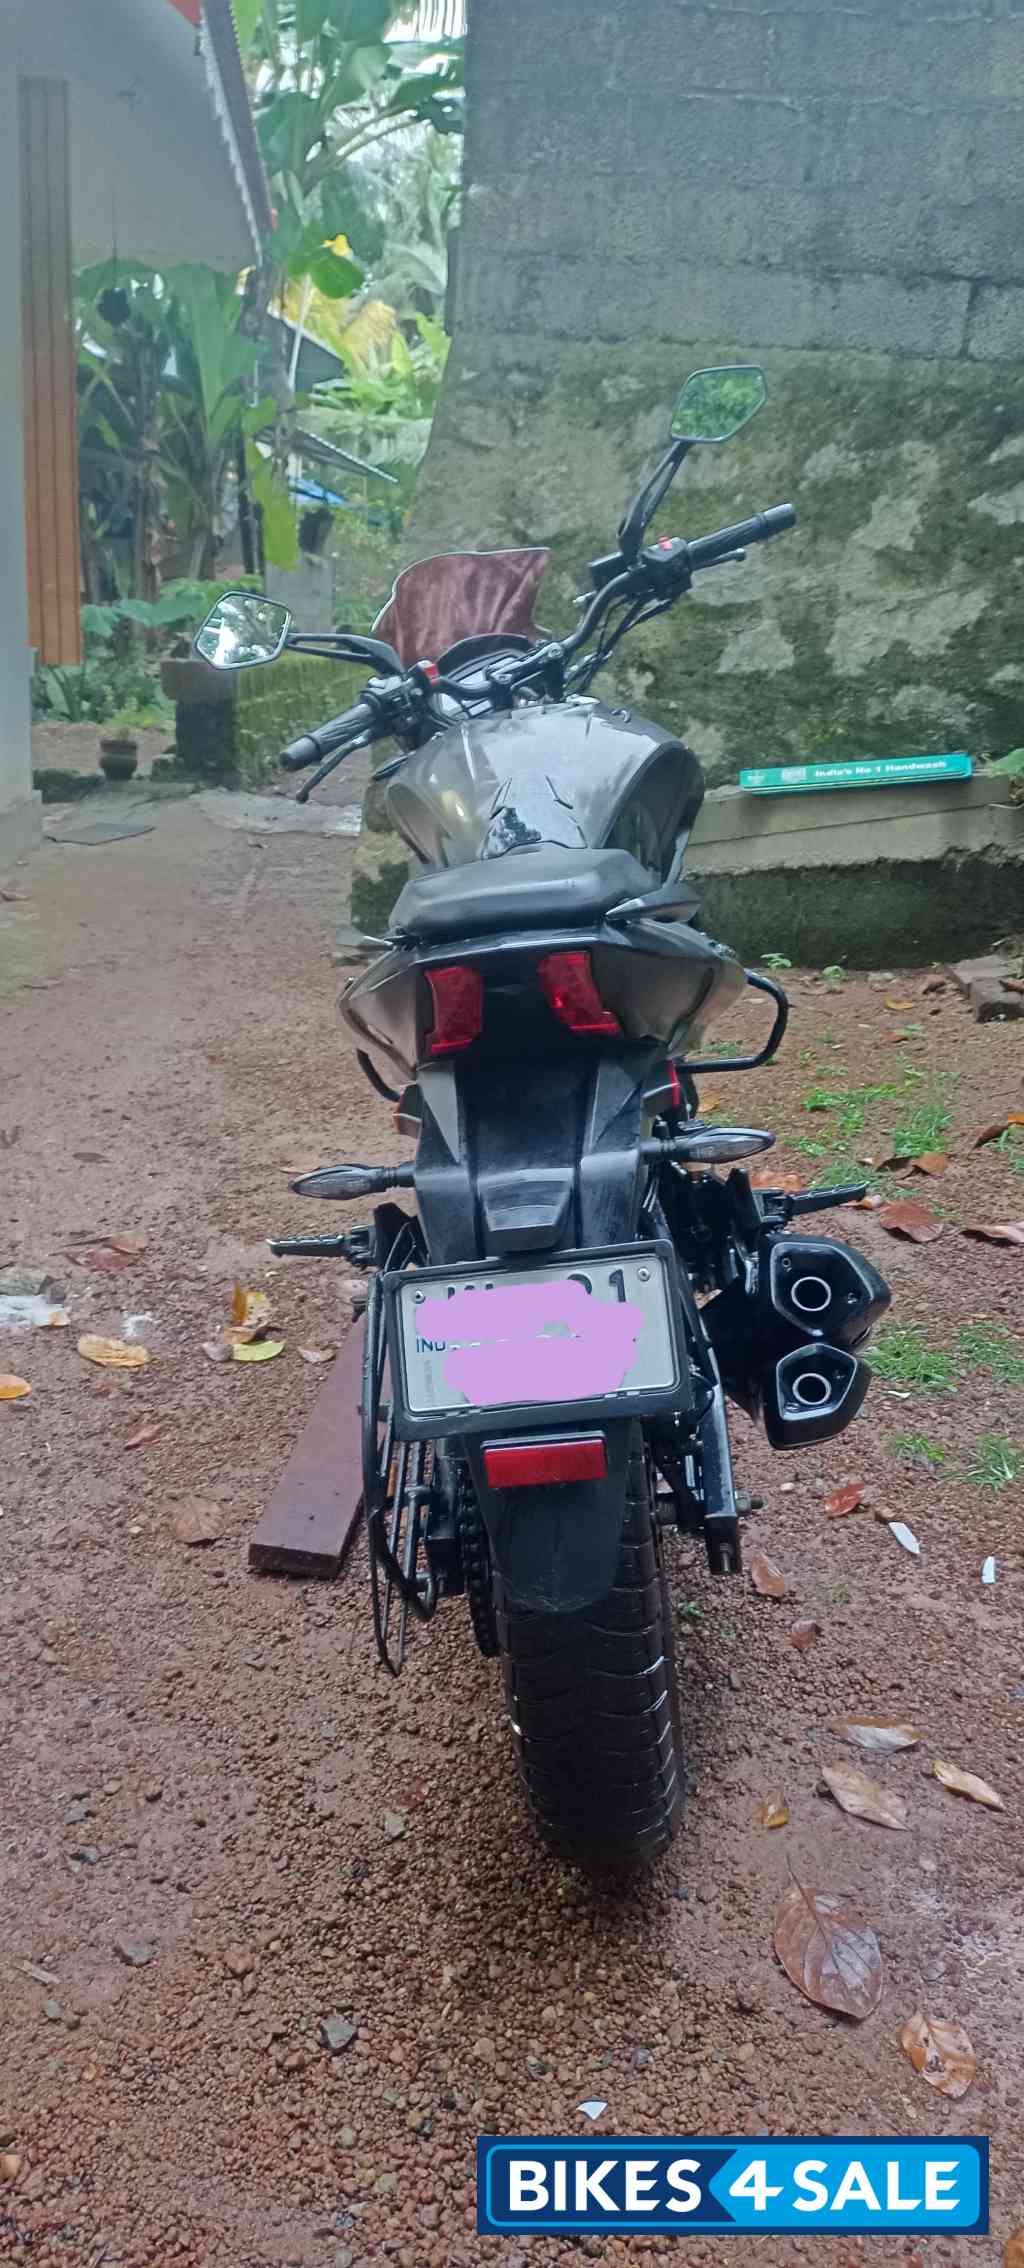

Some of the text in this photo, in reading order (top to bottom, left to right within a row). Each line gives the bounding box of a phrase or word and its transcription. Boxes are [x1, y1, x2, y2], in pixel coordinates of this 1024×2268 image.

[815, 766, 853, 778] India's
[874, 765, 882, 773] 1
[884, 760, 948, 772] Handwash
